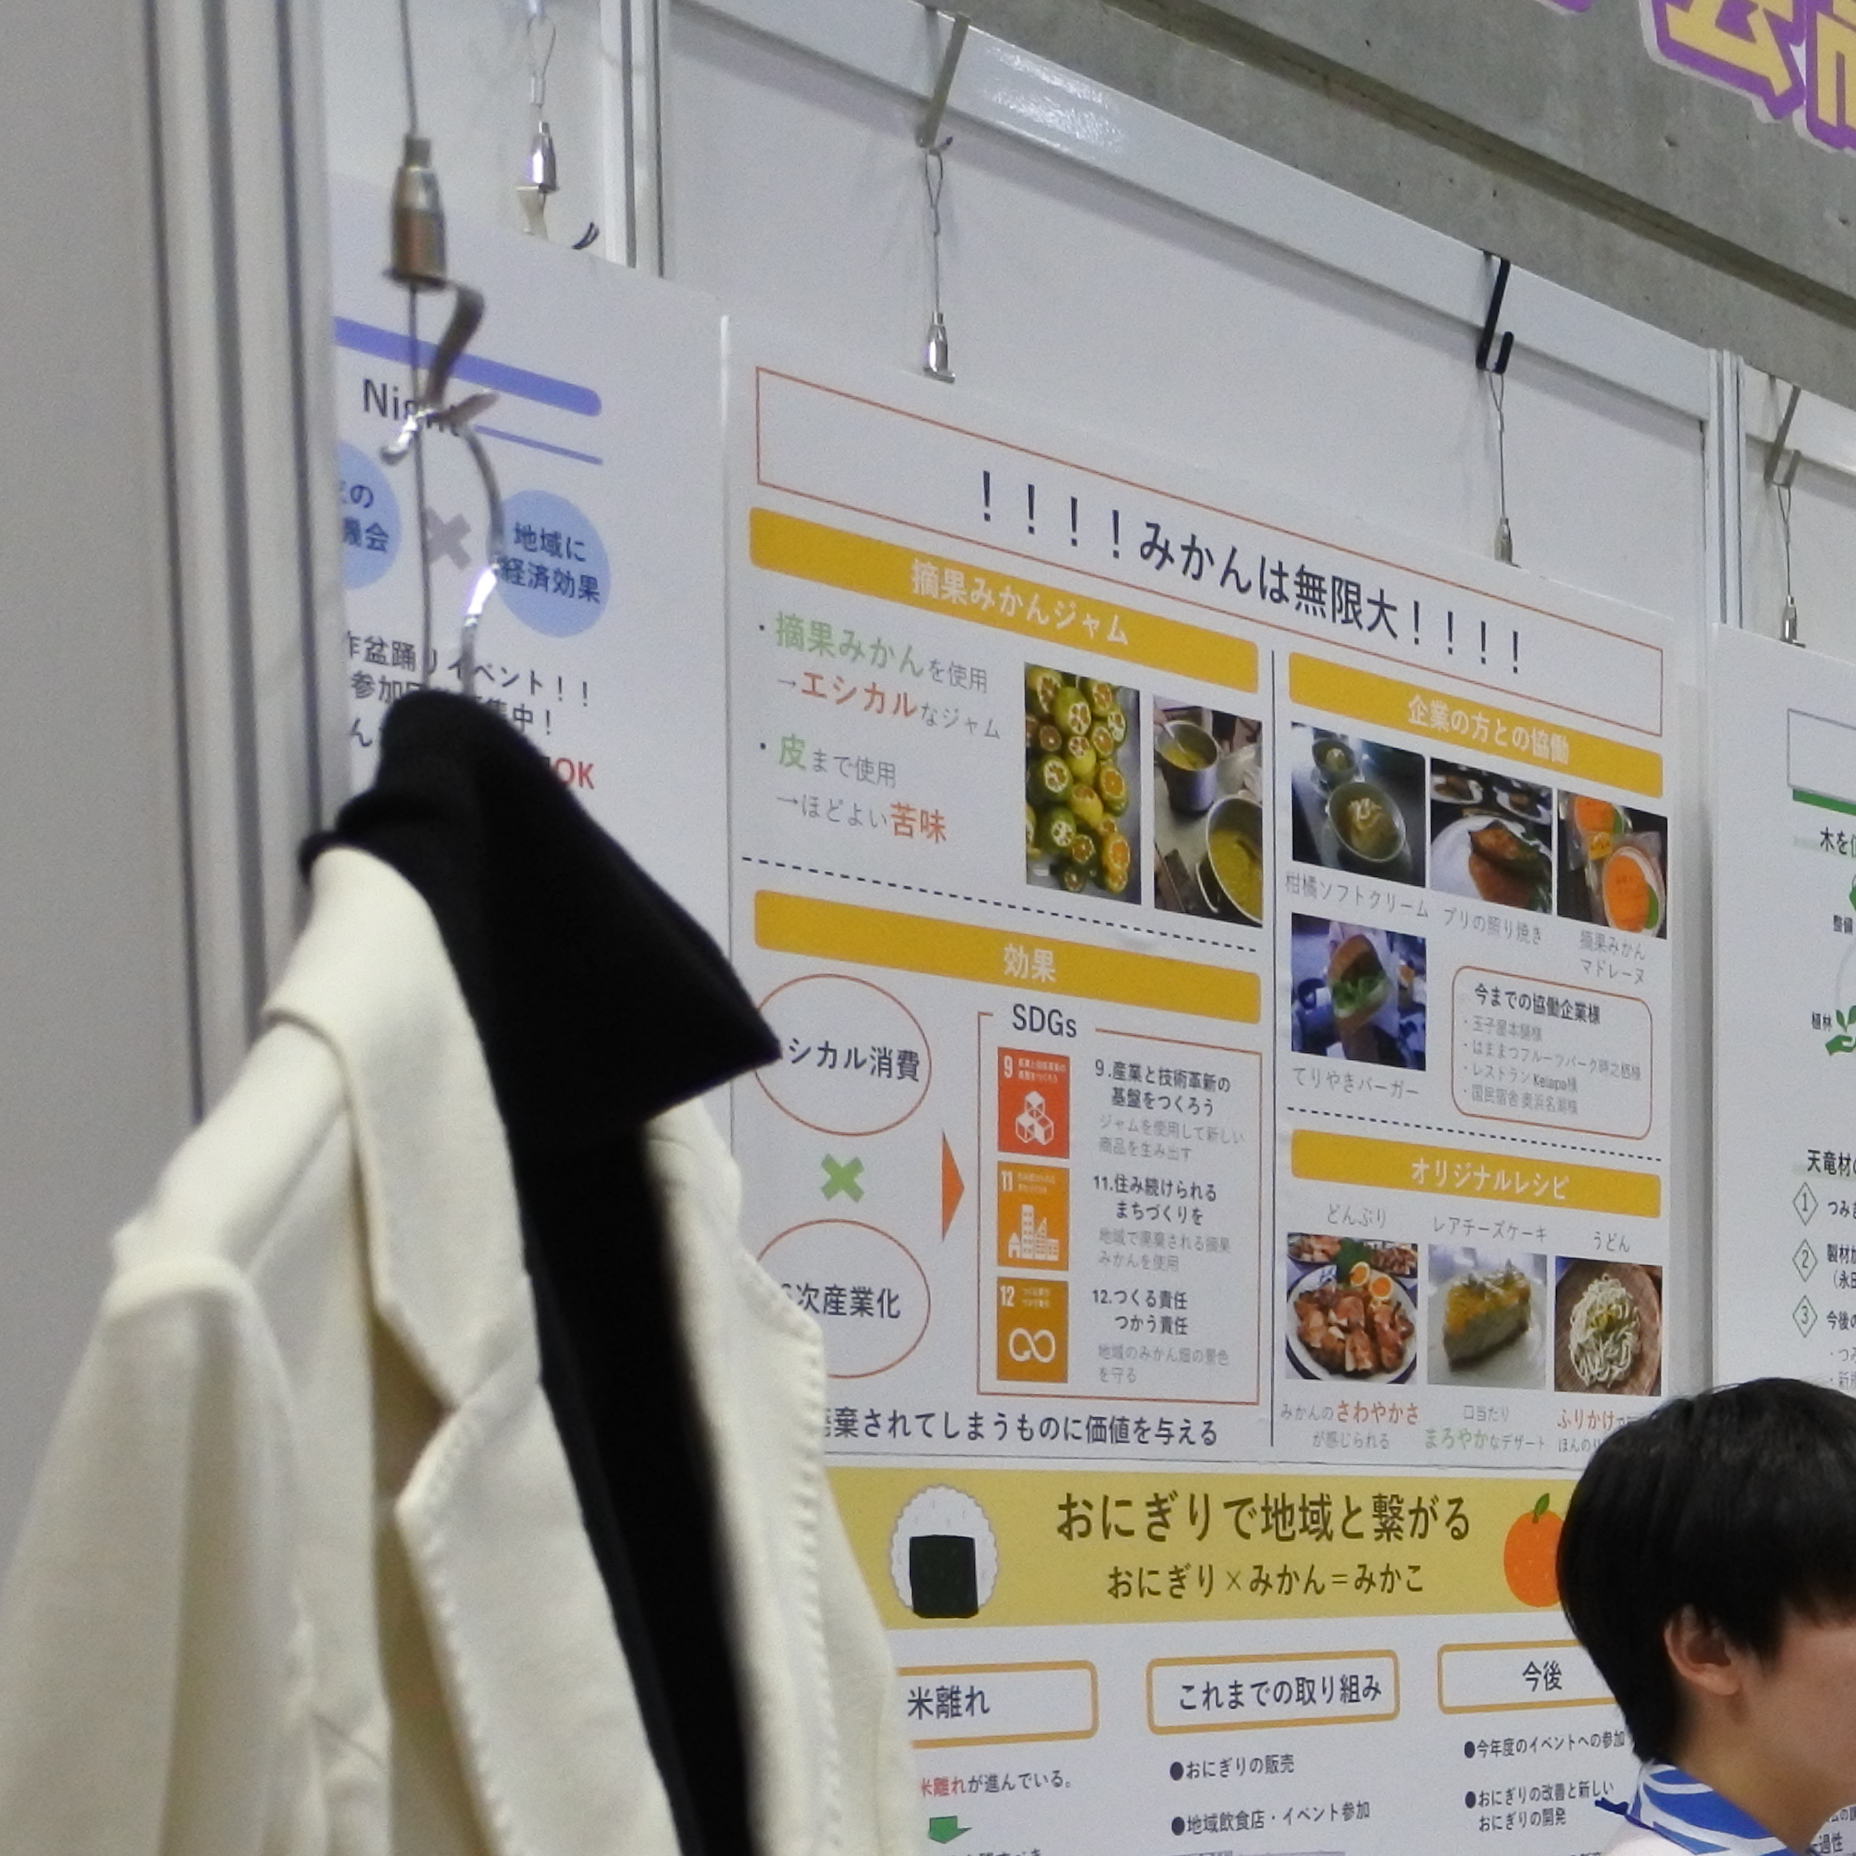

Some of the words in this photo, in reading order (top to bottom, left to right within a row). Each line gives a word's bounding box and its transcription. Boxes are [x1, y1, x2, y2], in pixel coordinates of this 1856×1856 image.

[514, 521, 587, 563] 地域に
[500, 555, 601, 604] 経済効果
[911, 559, 1129, 646] 摘果みかんジャム
[1408, 695, 1570, 766] 企業の方との協働
[778, 733, 897, 786] 皮まで使用
[1003, 943, 1057, 983] 効果
[1011, 1003, 1078, 1039] SDGs
[1411, 1158, 1570, 1200] オリジナルレシピ
[1327, 1203, 1388, 1227] どんぶり
[1433, 1215, 1548, 1241] レアチーズケーキ
[1592, 1230, 1630, 1253] うどん
[1056, 1491, 1472, 1544] おにぎりで地域と繋がる
[1179, 1674, 1382, 1712] これまでの取り組み
[1185, 1754, 1295, 1782] おにぎりの販売
